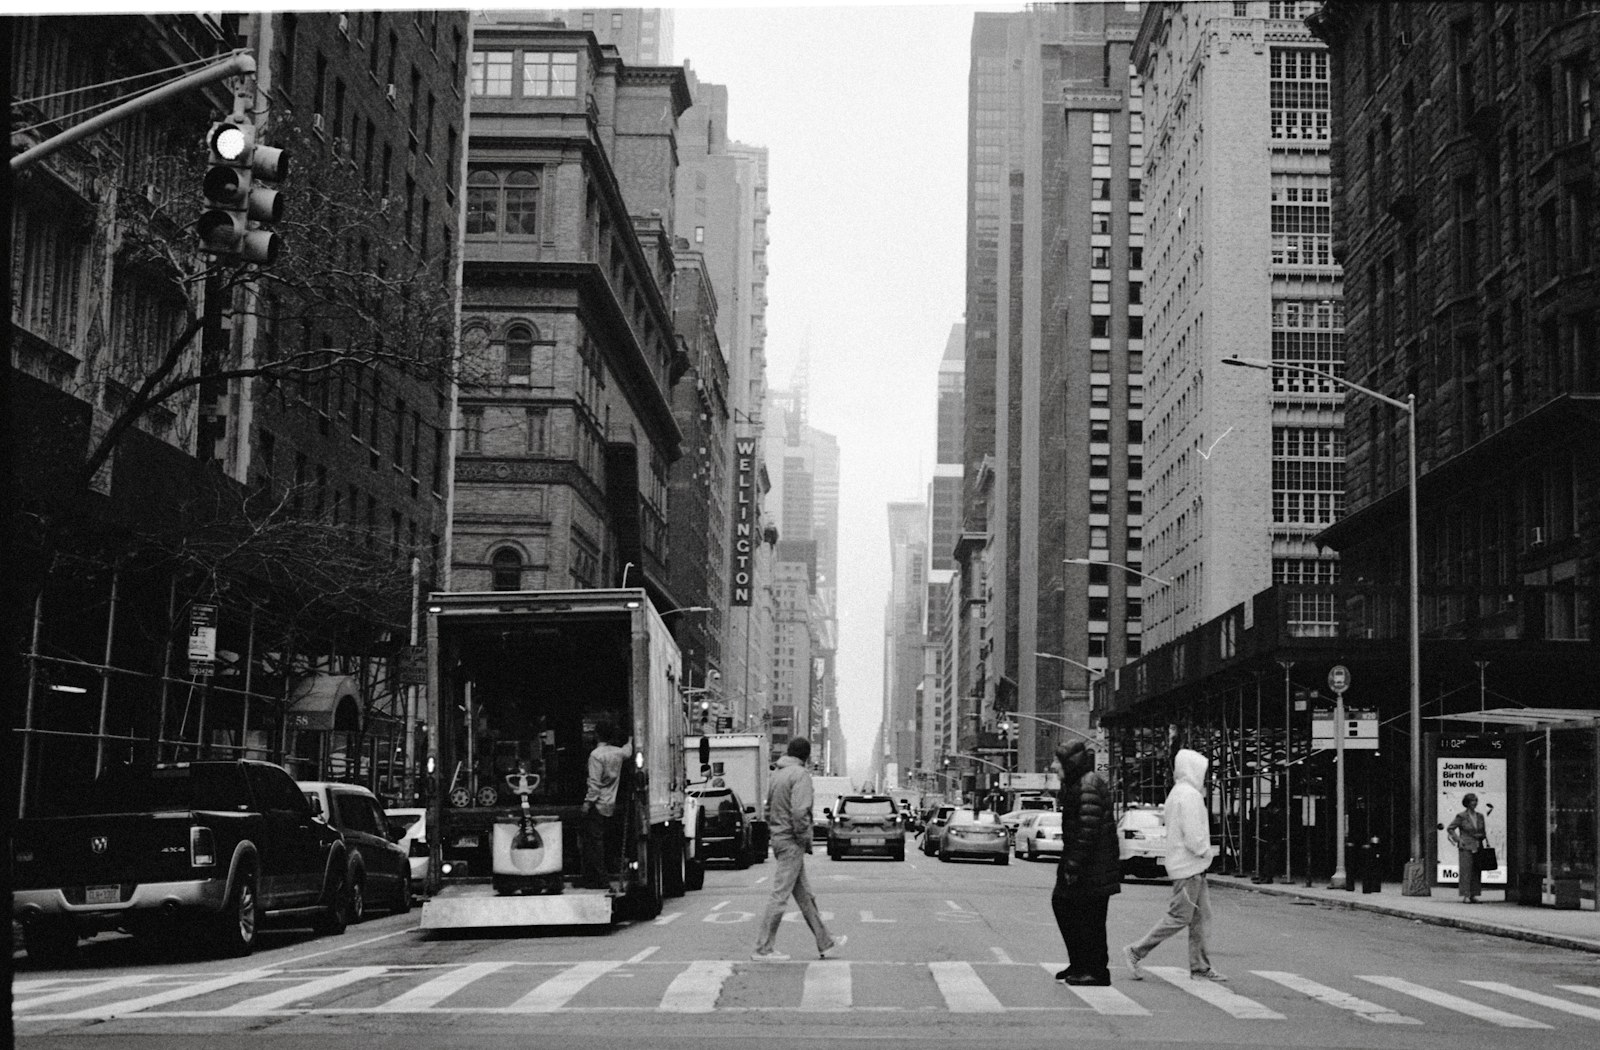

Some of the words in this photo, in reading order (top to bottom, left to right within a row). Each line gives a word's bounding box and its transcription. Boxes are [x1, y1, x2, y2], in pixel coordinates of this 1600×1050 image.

[735, 442, 755, 601] WELLINGTON
[295, 715, 309, 726] 58
[1097, 763, 1109, 772] 25
[1443, 762, 1464, 770] Joan
[1465, 762, 1488, 771] Miró:
[1443, 771, 1465, 779] Birth
[1465, 771, 1475, 779] of
[1443, 780, 1457, 788] the
[1458, 780, 1484, 788] World
[1442, 869, 1459, 879] Mo
